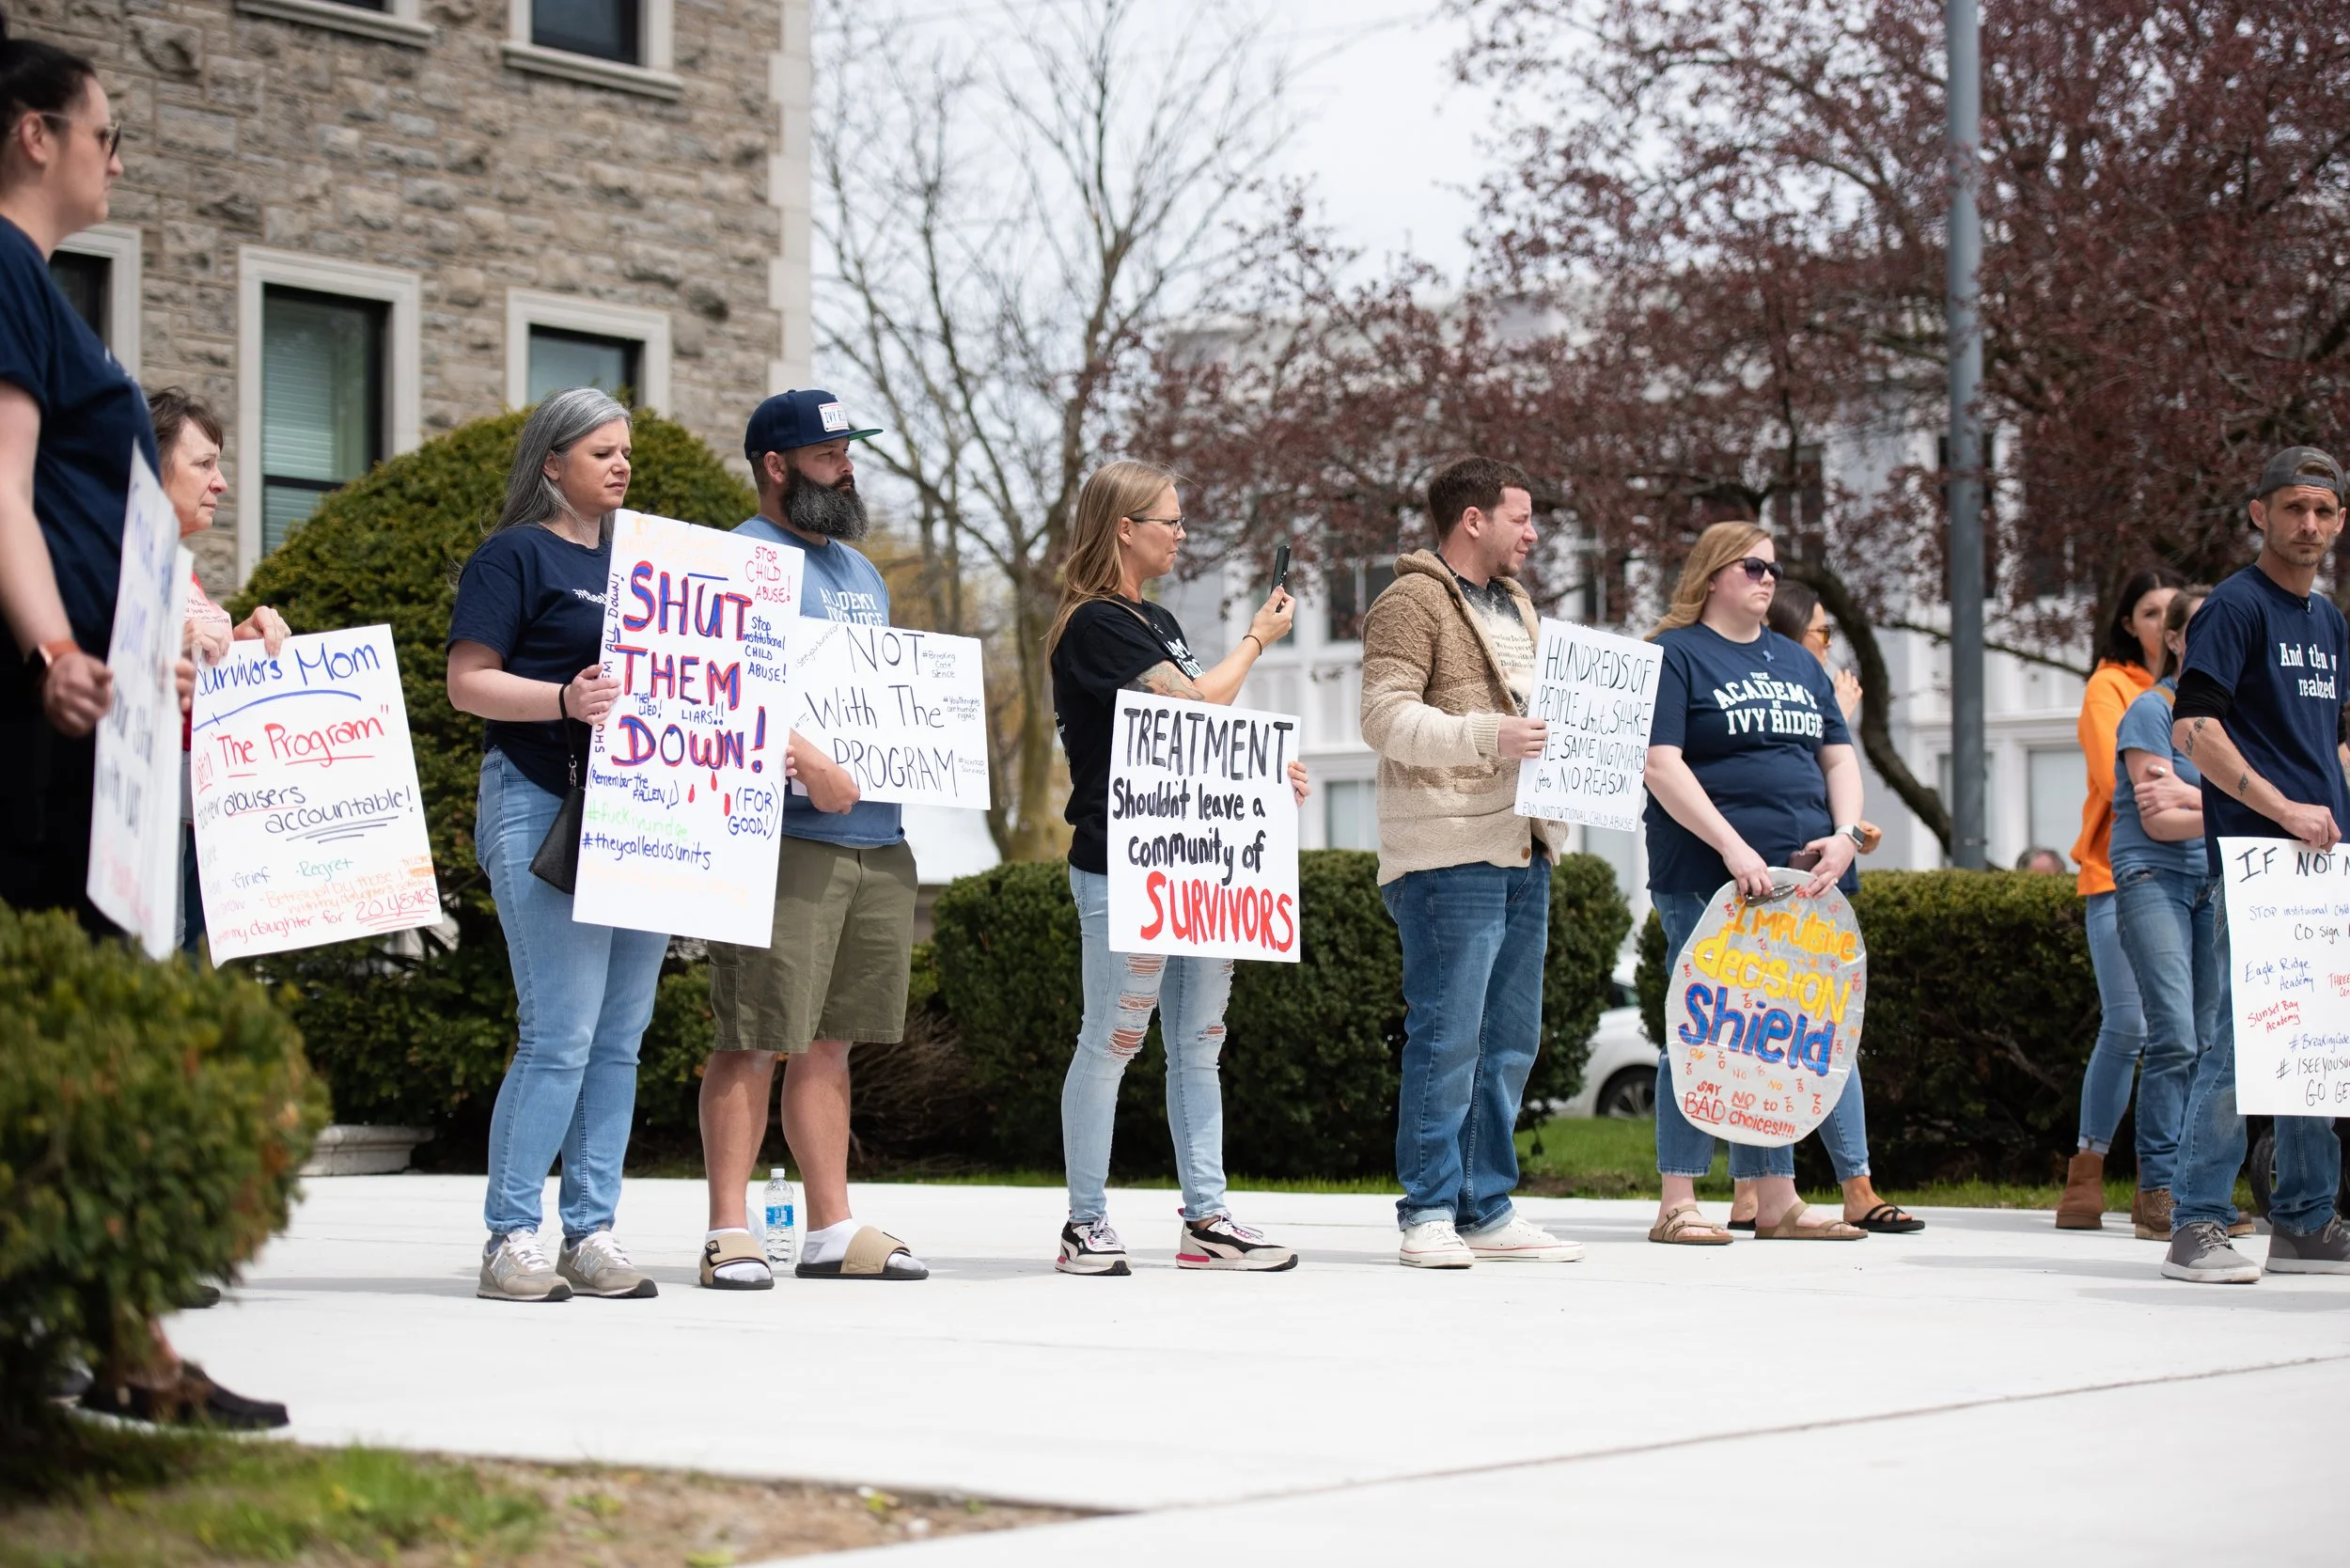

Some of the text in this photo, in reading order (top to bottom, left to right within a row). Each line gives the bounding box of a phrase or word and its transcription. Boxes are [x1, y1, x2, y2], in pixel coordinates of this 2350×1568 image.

[745, 560, 781, 583] CHILD
[622, 560, 753, 641] SHUT
[755, 575, 791, 604] ABUSE!
[819, 587, 878, 611] ADEMY
[294, 642, 381, 686] Mom
[744, 645, 773, 661] CHILD
[846, 626, 924, 676] NOT
[1545, 635, 1654, 696] HUNDREDS OF
[2279, 642, 2304, 666] And
[614, 645, 741, 711] THEM
[747, 661, 786, 684] ABUSE!
[2297, 672, 2337, 699] realzed
[805, 686, 877, 729] With
[888, 684, 945, 728] The
[1713, 680, 1818, 710] ACADEMY
[1538, 684, 1579, 727] PEOPLE
[1609, 699, 1652, 737] SHARE
[1726, 708, 1825, 739] IVY RIDGE
[611, 706, 766, 774] DOWN!
[1123, 708, 1293, 784] TREATMENT
[1560, 734, 1596, 760] SAME
[634, 773, 649, 790] the
[834, 738, 958, 798] PROGRAM
[1559, 766, 1580, 793] NO
[1583, 766, 1634, 796] REASON
[224, 786, 306, 816] abusers
[264, 785, 415, 834] accountable!
[1198, 782, 1246, 822] leave
[1252, 796, 1266, 819] a
[1523, 801, 1538, 816] END
[1590, 810, 1608, 826] CHILD
[1609, 815, 1634, 830] ABUSE
[1128, 826, 1266, 886] community of
[2235, 846, 2278, 883] IF
[2295, 852, 2336, 877] NOT
[249, 915, 315, 938] daughter
[321, 909, 345, 925] for
[355, 900, 384, 922] 20
[1140, 870, 1294, 952] SURVIVORS
[2249, 905, 2278, 921] STOP
[2245, 957, 2311, 985] Eagle Ridge
[2280, 976, 2314, 993] Academy
[1742, 993, 1752, 1009] NO
[2281, 1000, 2300, 1011] Bay
[1678, 982, 1836, 1076] Shield
[2265, 1013, 2301, 1033] Academy
[1717, 1050, 1726, 1070] NO
[1684, 1091, 1727, 1121] BAD
[1697, 1080, 1778, 1112] SAY NO to
[1812, 1092, 1822, 1115] NO
[2305, 1079, 2326, 1106] GO
